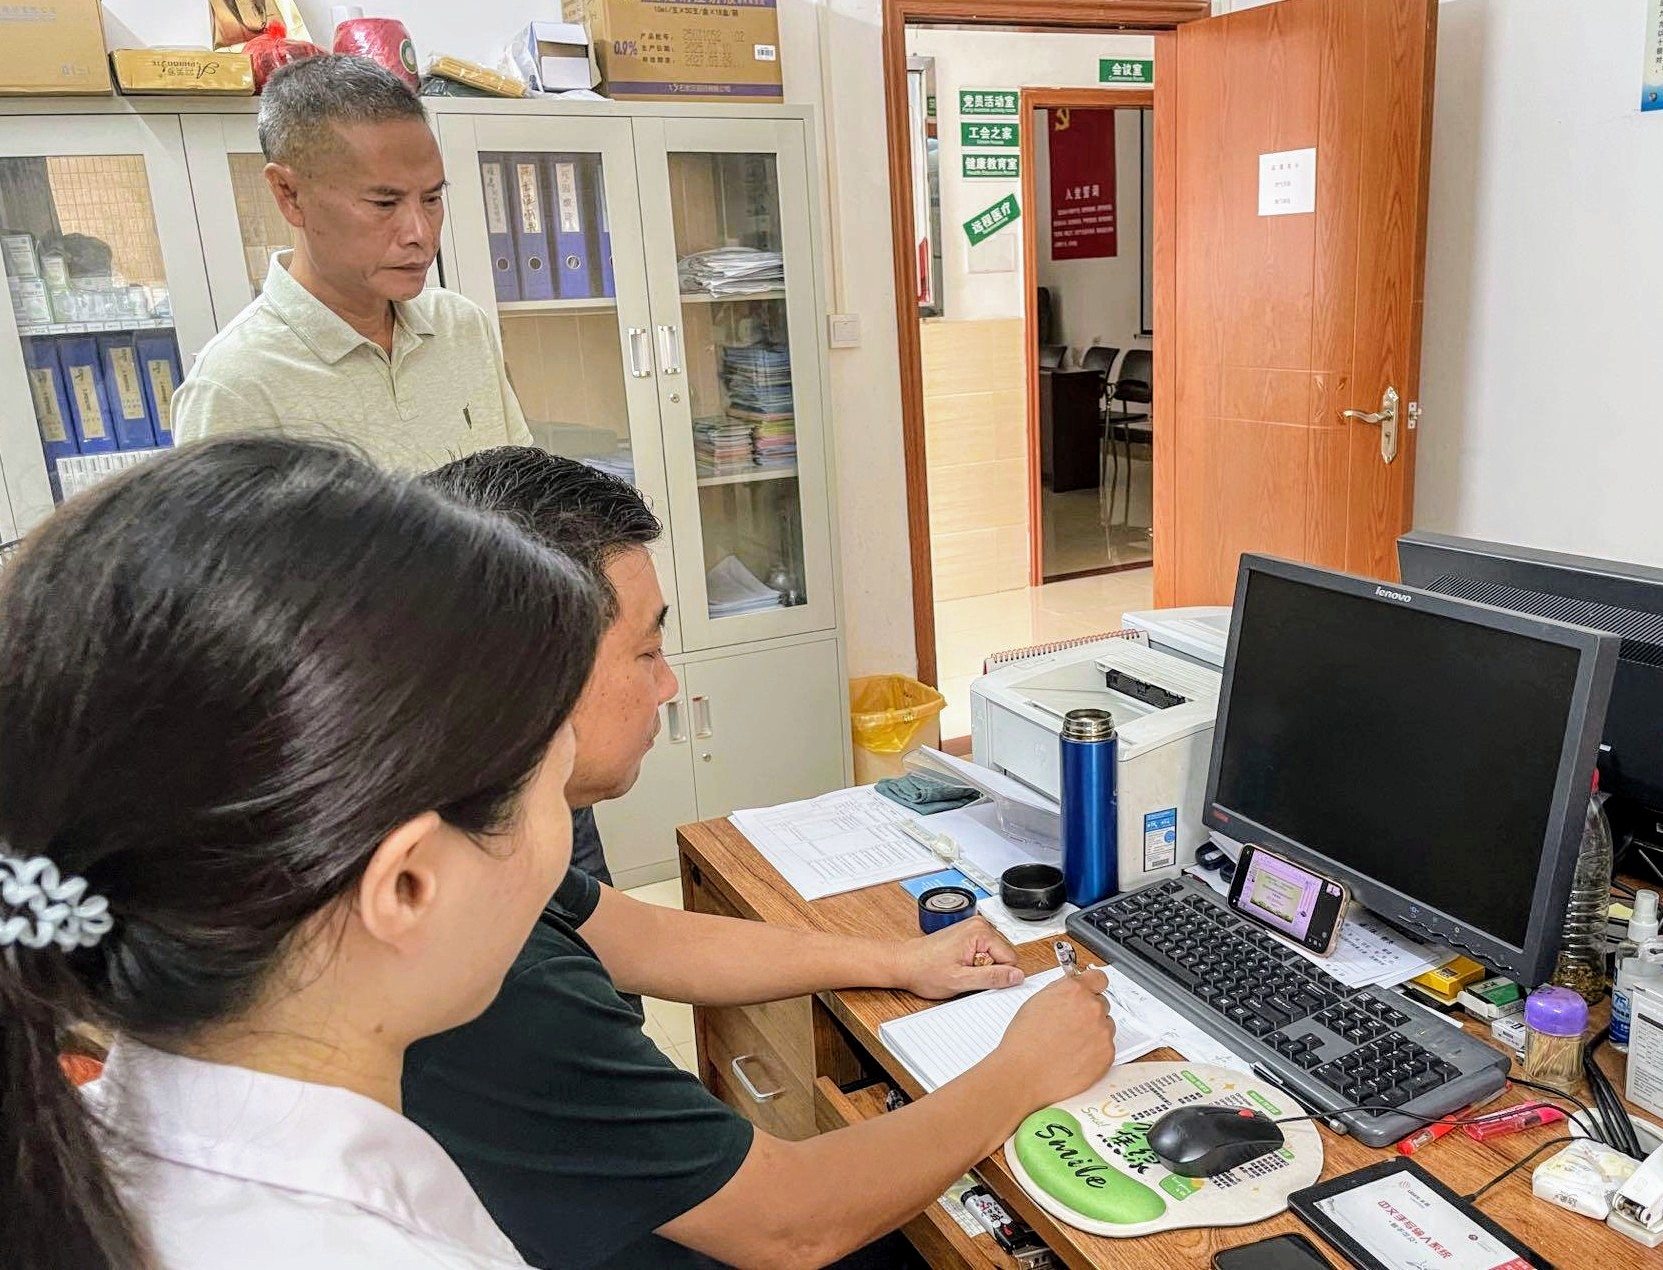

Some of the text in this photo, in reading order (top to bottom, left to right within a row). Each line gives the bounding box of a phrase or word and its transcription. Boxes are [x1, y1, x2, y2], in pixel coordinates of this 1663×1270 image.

[613, 40, 638, 56] 0.9%
[1111, 62, 1143, 76] 会议室
[963, 94, 1015, 108] 党员活动室
[968, 126, 1013, 140] 工会之家
[965, 157, 1018, 170] 健康教育室
[970, 201, 1011, 235] 远程医疗
[1375, 586, 1412, 603] lenovo
[1034, 1123, 1109, 1190] Smile
[1377, 1200, 1455, 1260] 中文手写输入系统
